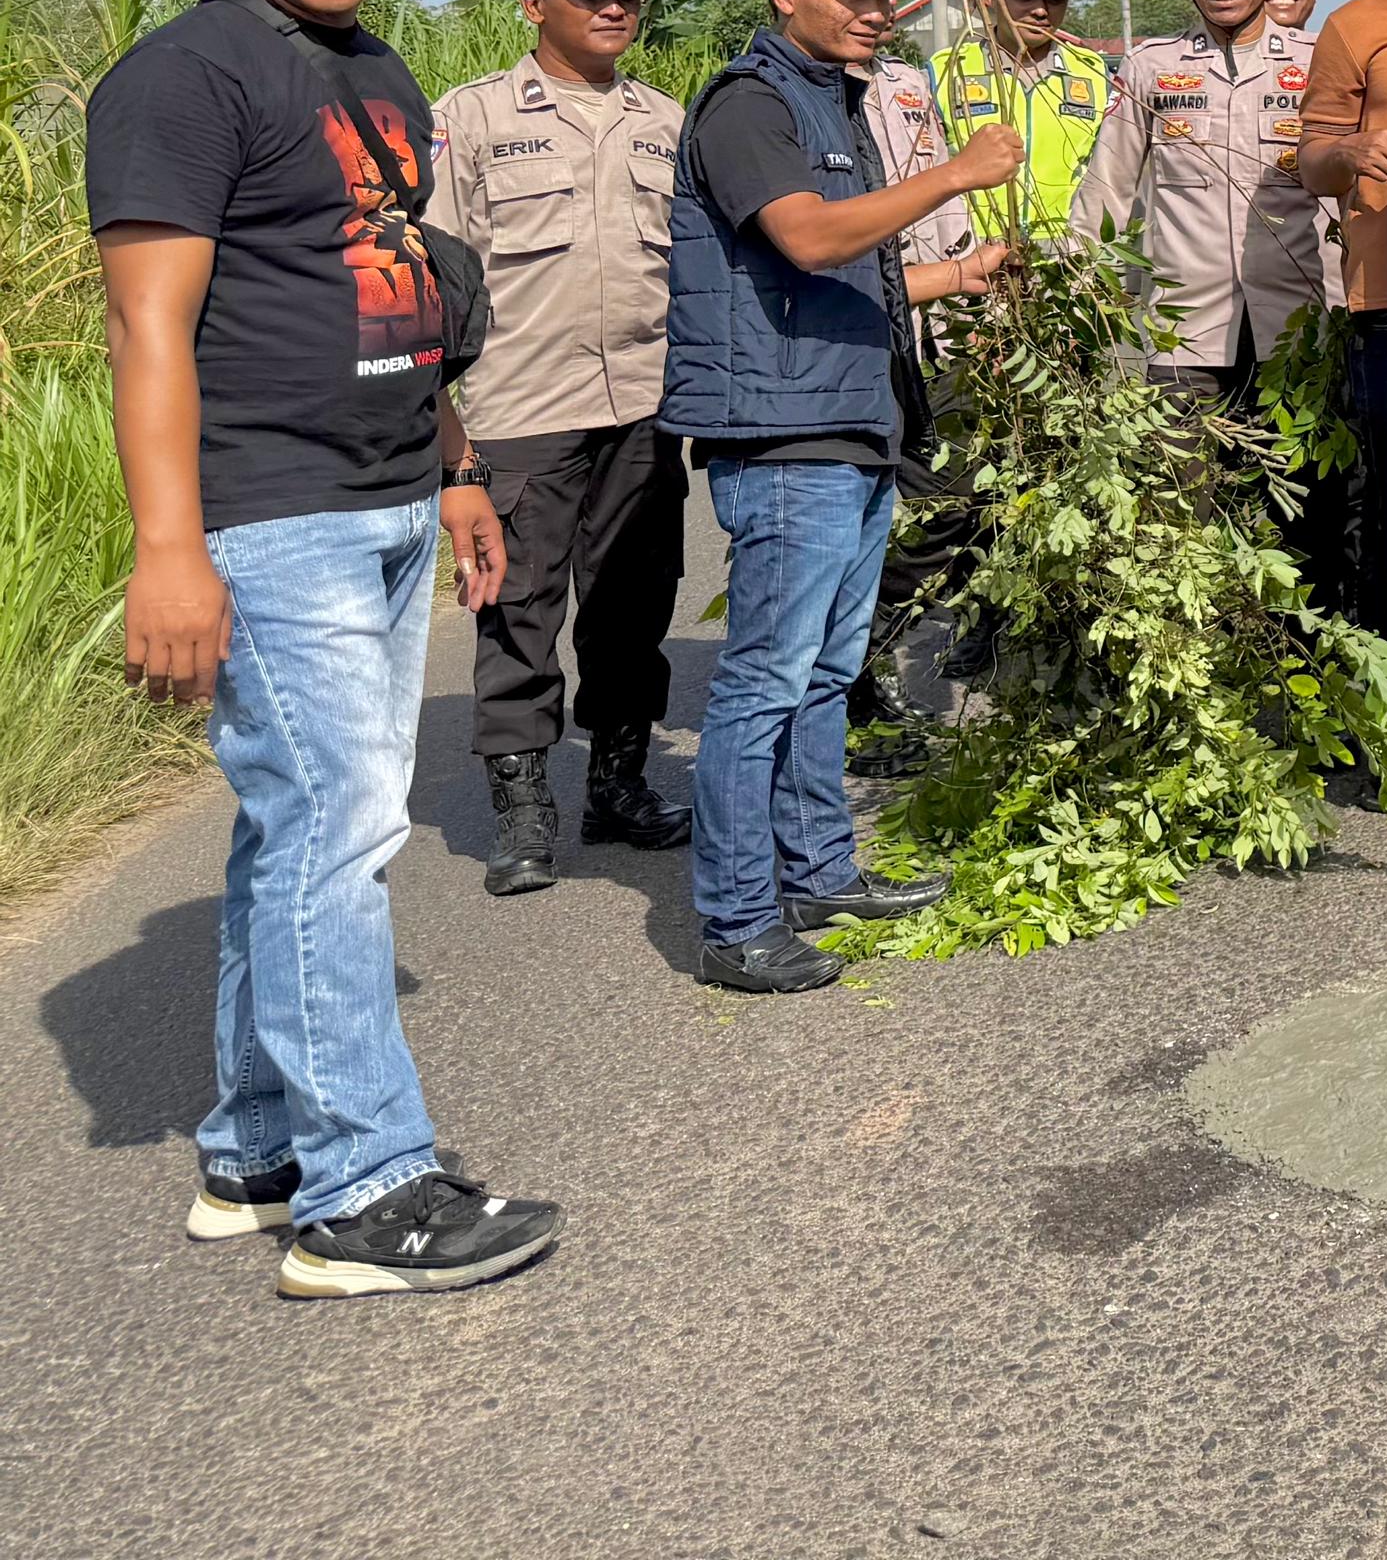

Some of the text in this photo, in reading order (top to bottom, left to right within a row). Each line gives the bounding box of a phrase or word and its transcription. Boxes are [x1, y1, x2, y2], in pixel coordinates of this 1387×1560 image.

[1263, 95, 1300, 110] POL
[491, 138, 555, 158] ERIK
[632, 140, 676, 163] POLR
[357, 347, 444, 376] INDERA WASP
[399, 1230, 433, 1255] N
